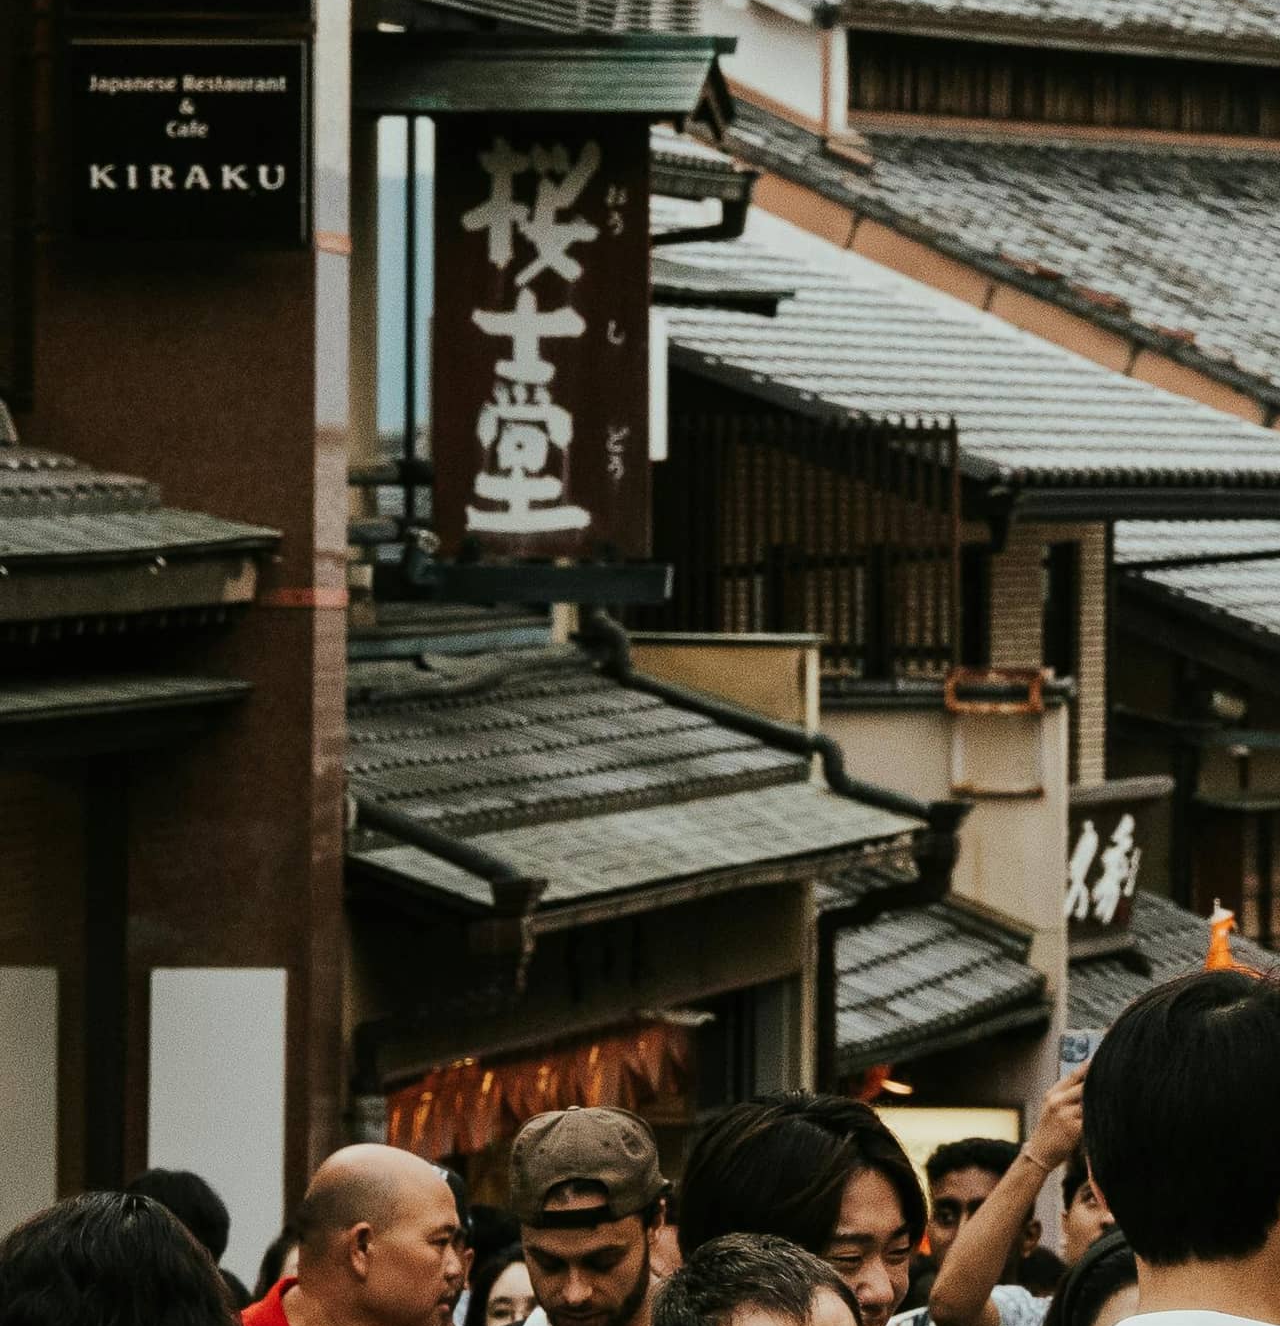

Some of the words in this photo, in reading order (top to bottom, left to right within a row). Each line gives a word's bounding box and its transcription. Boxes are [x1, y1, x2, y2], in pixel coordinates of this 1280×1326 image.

[90, 75, 178, 96] Japanese
[182, 75, 287, 93] Restaurant
[179, 98, 195, 115] &
[89, 163, 286, 191] KIRAKU
